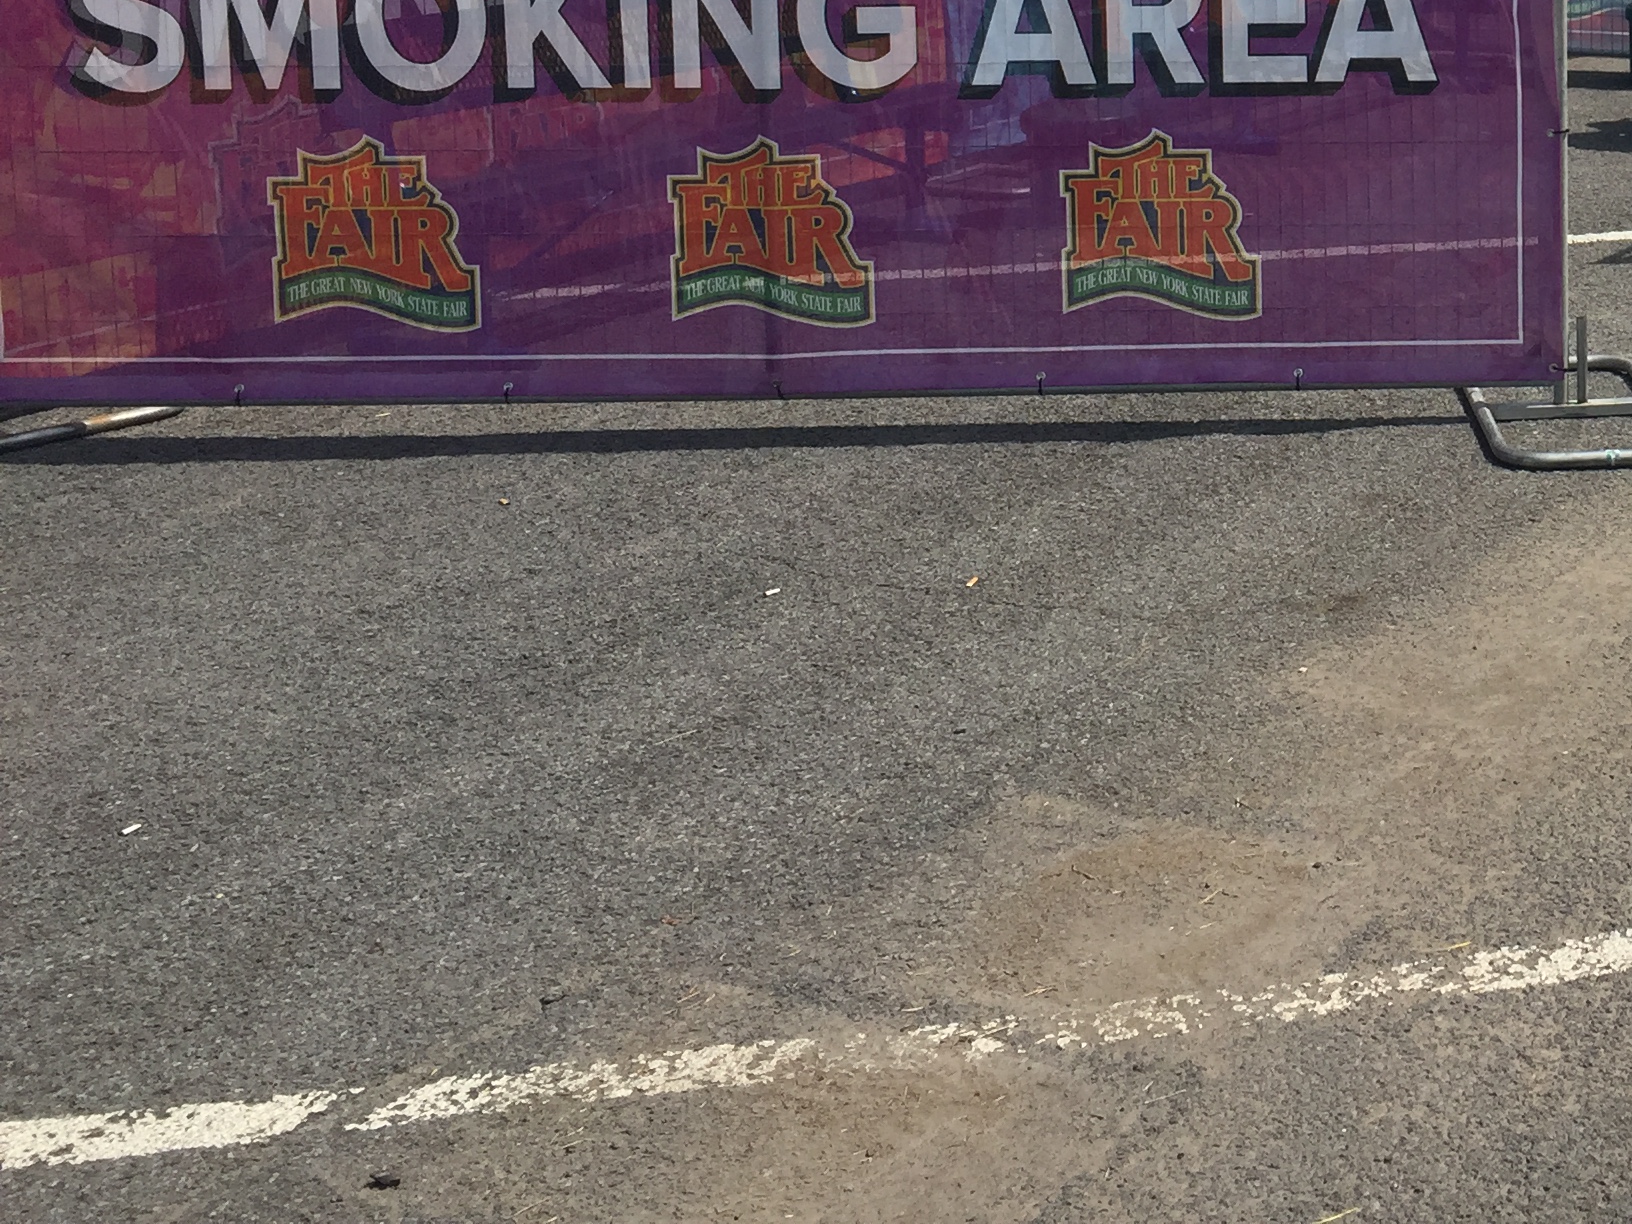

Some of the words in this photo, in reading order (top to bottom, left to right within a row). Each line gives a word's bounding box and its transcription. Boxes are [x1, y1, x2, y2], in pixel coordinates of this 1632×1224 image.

[309, 148, 430, 208] THE
[708, 148, 824, 207] THE
[1100, 142, 1214, 199] THE
[278, 186, 471, 291] FAIR
[679, 185, 865, 289] FAIR
[1071, 179, 1253, 281] FAIR
[288, 284, 310, 302] THE
[311, 277, 346, 295] GREAT
[350, 278, 372, 295] NEW
[376, 284, 405, 308] YORK
[408, 295, 439, 317] STATE
[443, 301, 468, 317] FAIR
[685, 281, 707, 301] THE
[707, 276, 740, 295] GREAT
[743, 276, 765, 295] NEW
[769, 284, 798, 306] YORK
[801, 294, 834, 313] STATE
[837, 296, 862, 313] FAIR
[1076, 274, 1098, 293] THE
[1098, 268, 1132, 285] GREAT
[1136, 268, 1159, 286] NEW
[1161, 273, 1189, 298] YORK
[1192, 284, 1222, 306] STATE
[1225, 290, 1249, 306] FAIR
